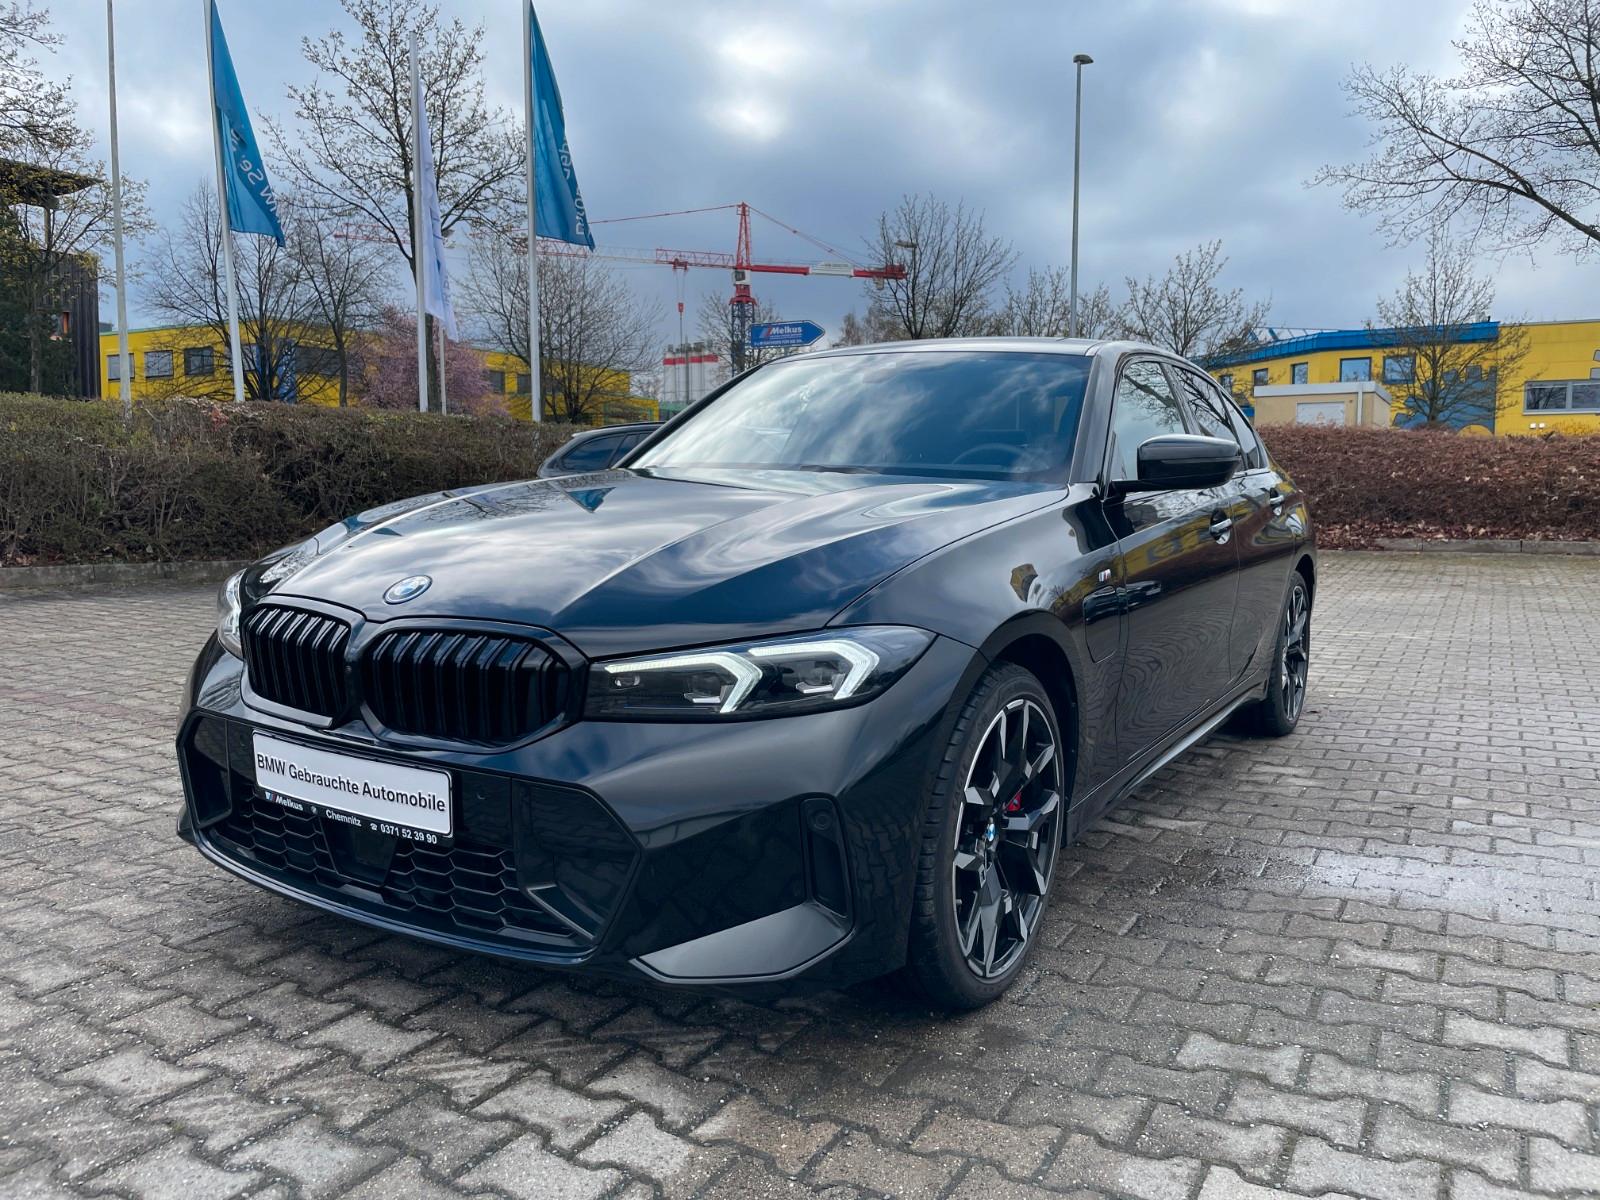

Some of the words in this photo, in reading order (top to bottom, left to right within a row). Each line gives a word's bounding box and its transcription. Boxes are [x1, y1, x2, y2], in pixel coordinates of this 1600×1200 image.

[770, 326, 802, 334] Melkus
[257, 754, 286, 776] BMW
[288, 765, 359, 793] Gebrauchte
[362, 782, 446, 811] Automobile
[275, 795, 304, 812] Melkus
[325, 809, 362, 827] Chemnitz
[380, 823, 400, 836] 0371
[401, 828, 412, 839] 52
[413, 831, 424, 841] 39
[426, 833, 438, 845] 90
